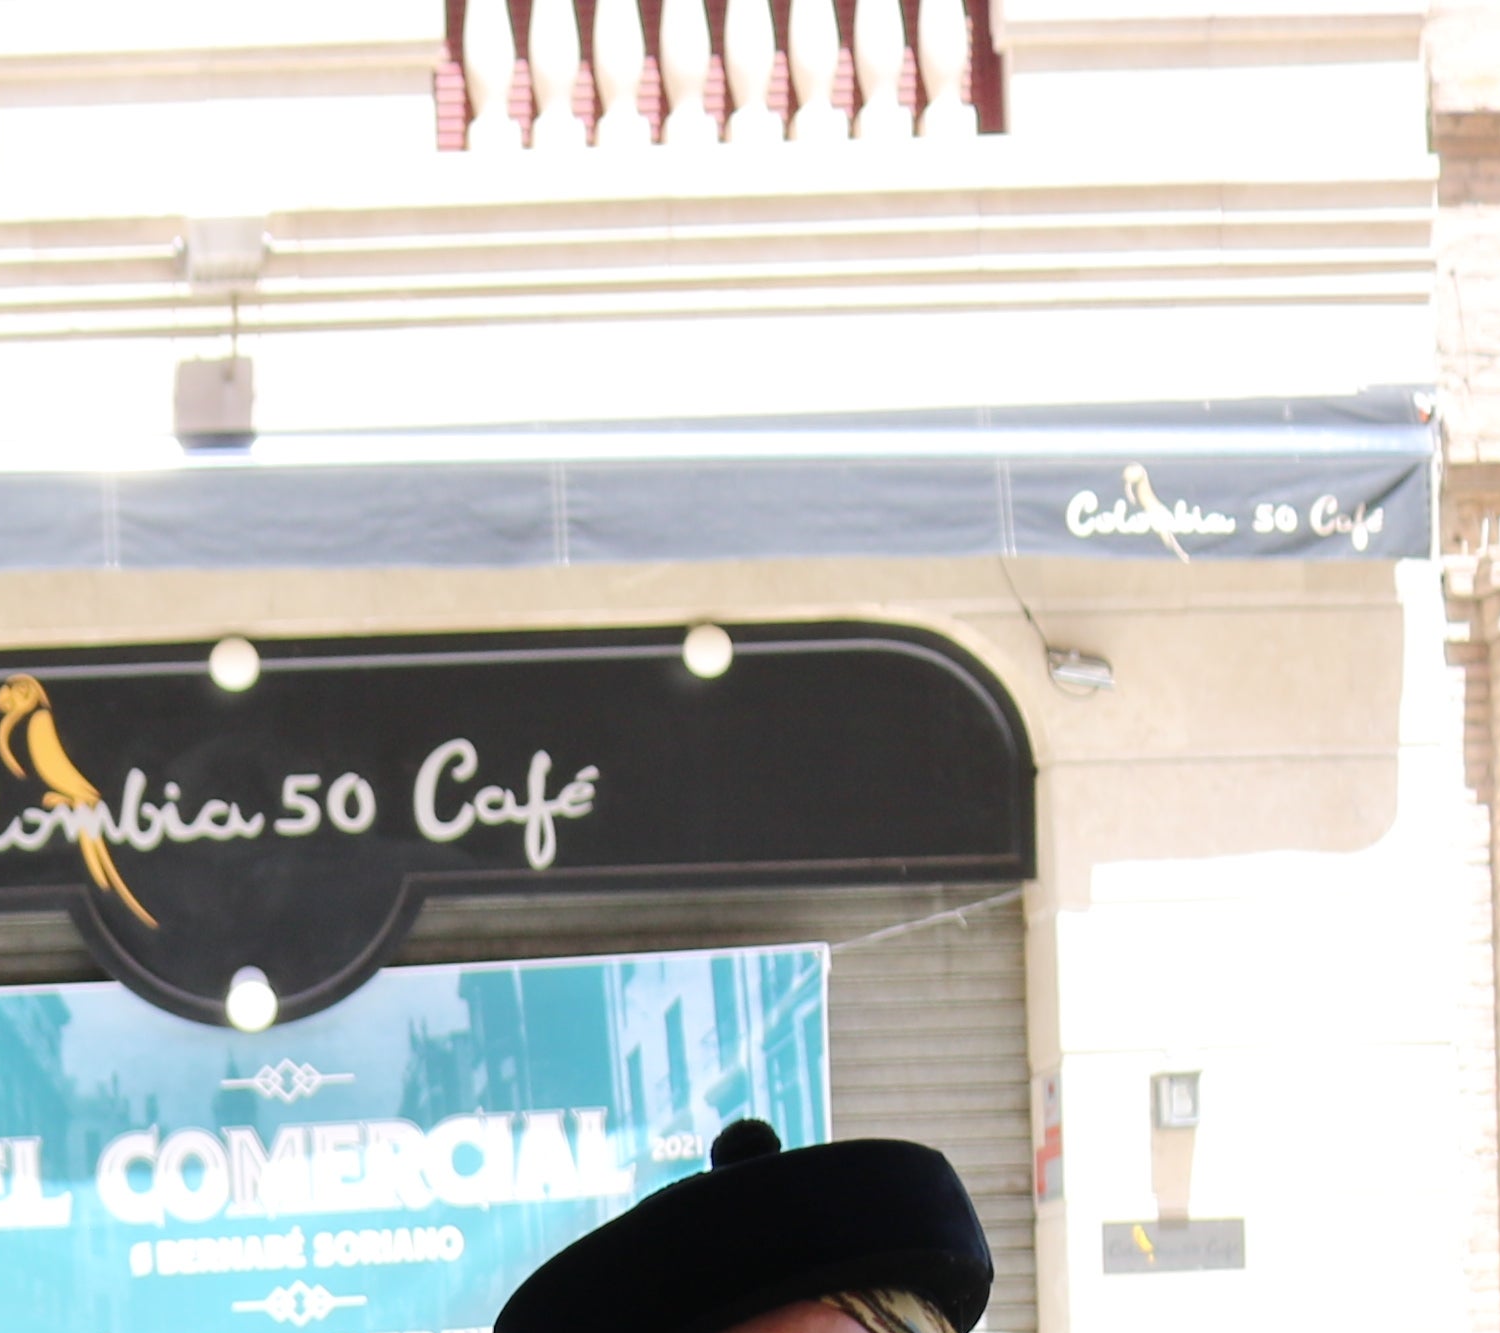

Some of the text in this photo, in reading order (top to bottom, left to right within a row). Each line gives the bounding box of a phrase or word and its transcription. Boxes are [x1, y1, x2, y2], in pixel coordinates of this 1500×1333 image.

[1252, 503, 1298, 534] 50
[273, 773, 377, 836] 50
[413, 738, 599, 870] Café
[95, 1106, 638, 1227] COMERCIAL
[651, 1134, 705, 1162] 2021
[156, 1226, 306, 1276] BERNABÉ
[313, 1226, 465, 1267] SORIANO
